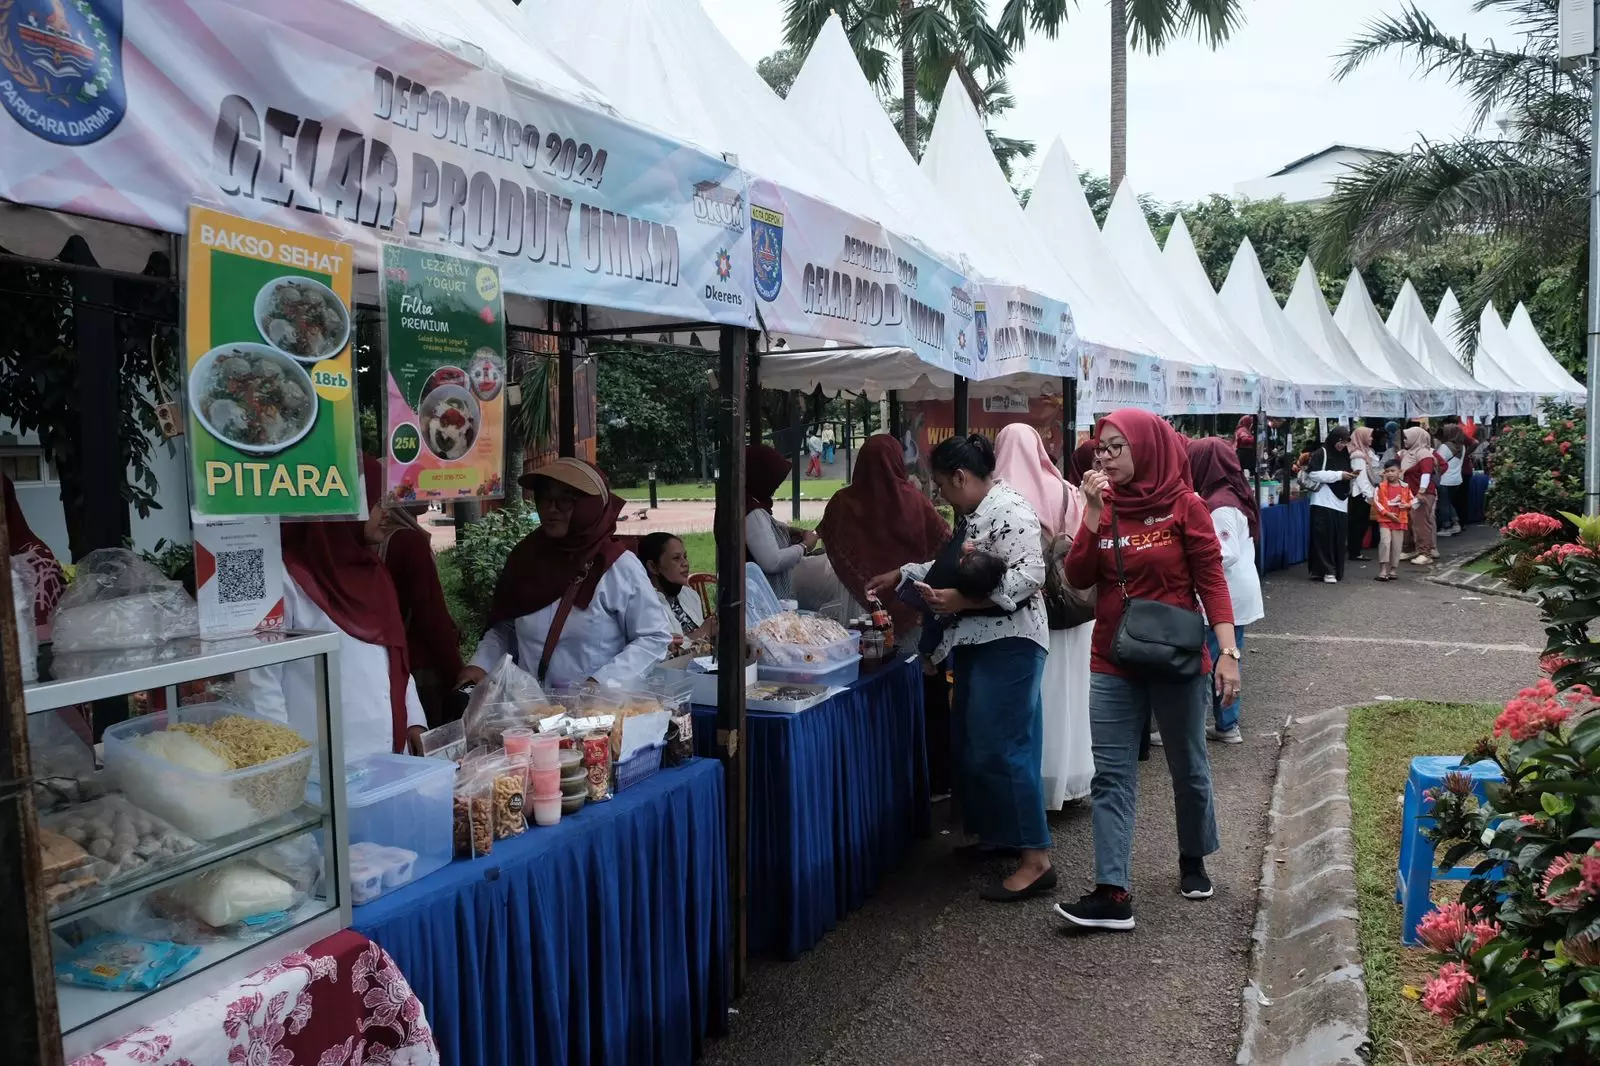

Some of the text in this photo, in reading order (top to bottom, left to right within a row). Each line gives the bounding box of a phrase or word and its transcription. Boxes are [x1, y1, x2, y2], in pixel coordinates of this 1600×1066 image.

[0, 80, 115, 137] PARICARA DARMA
[373, 66, 609, 190] DEPOK EXPO 2024
[212, 94, 680, 287] GELAR PRODUK UMKM
[199, 224, 344, 274] BAKSO SEHAT
[426, 276, 468, 293] YOGURT
[705, 284, 743, 306] Dkerens
[802, 262, 852, 321] GELAR
[401, 316, 450, 333] PREMIUM
[314, 369, 349, 388] 18rb
[394, 437, 417, 449] 25K
[205, 460, 350, 497] PITARA
[1131, 529, 1171, 546] EXPO
